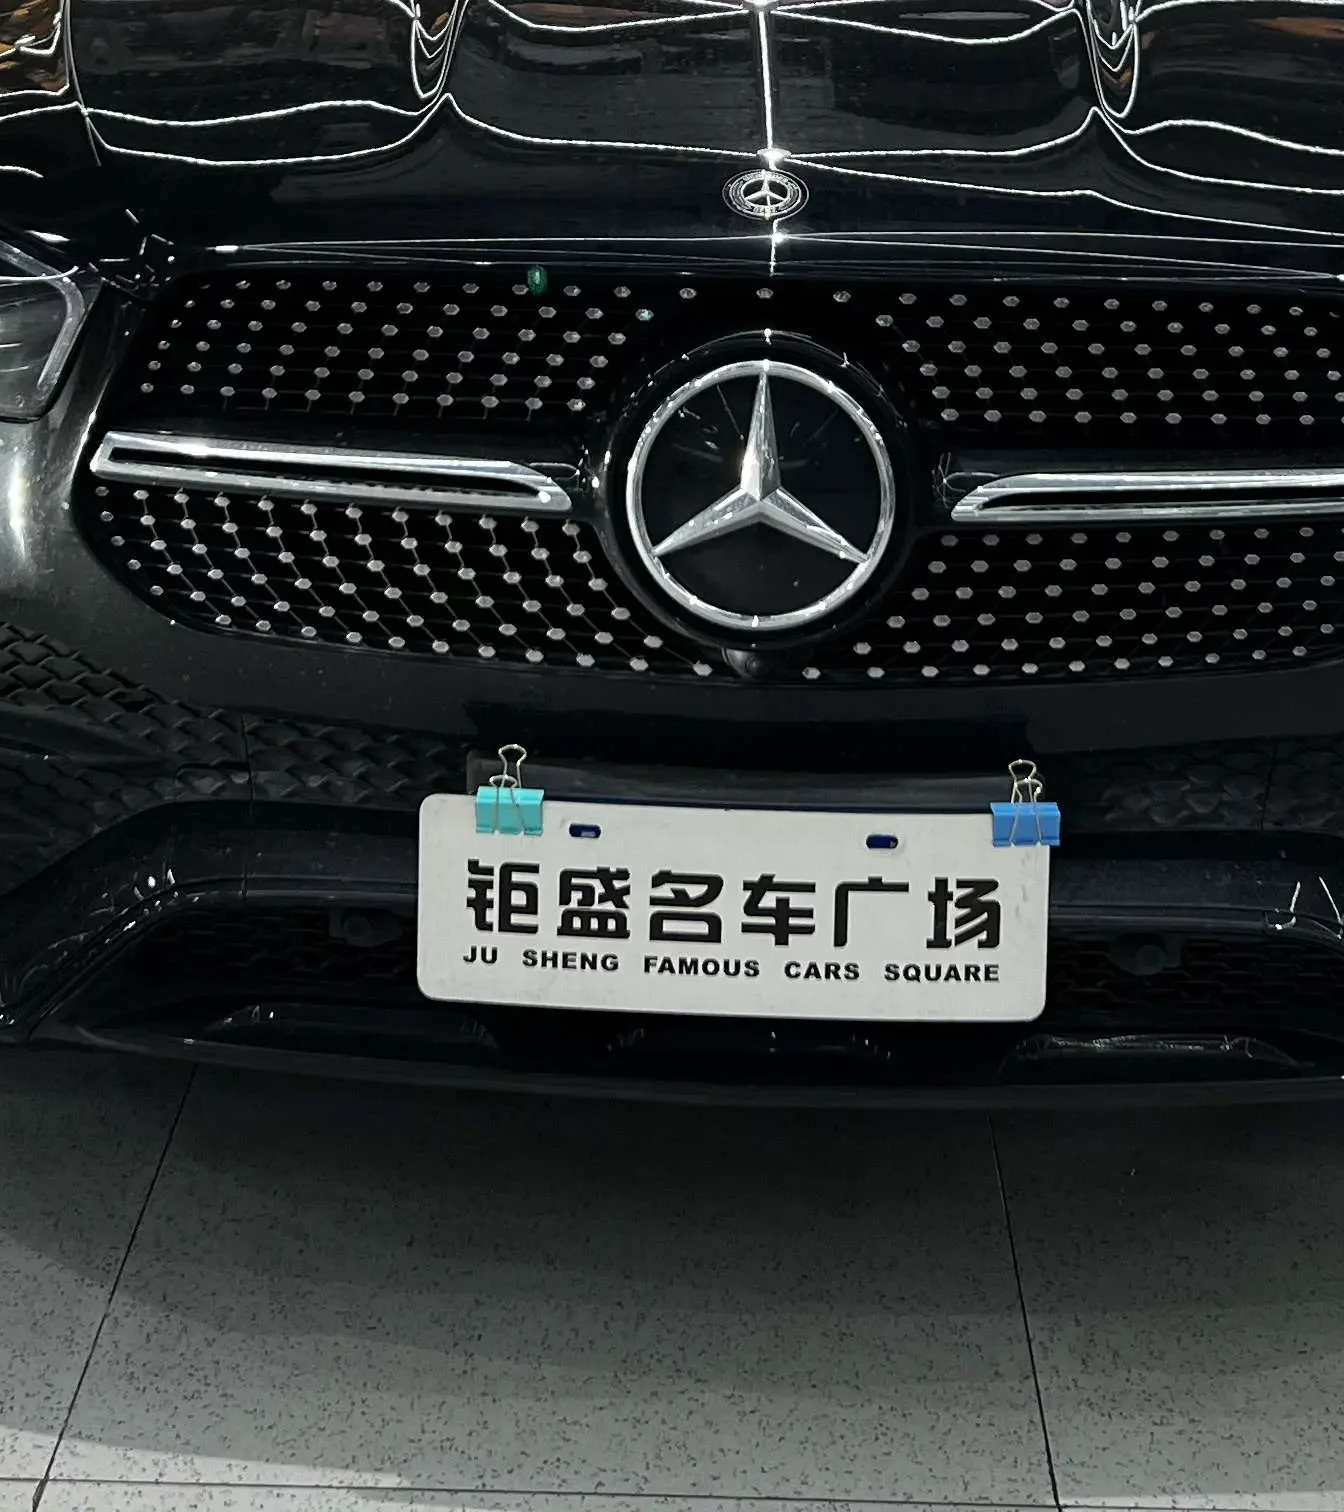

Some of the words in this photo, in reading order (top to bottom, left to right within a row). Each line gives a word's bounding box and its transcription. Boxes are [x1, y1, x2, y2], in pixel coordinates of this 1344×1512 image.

[466, 858, 1001, 949] 钜盛名车广场
[463, 946, 499, 965] JU
[522, 949, 620, 972] SHENG
[643, 955, 761, 978] FAMOUS
[783, 960, 861, 981] CARS
[883, 962, 1000, 983] SQUARE
